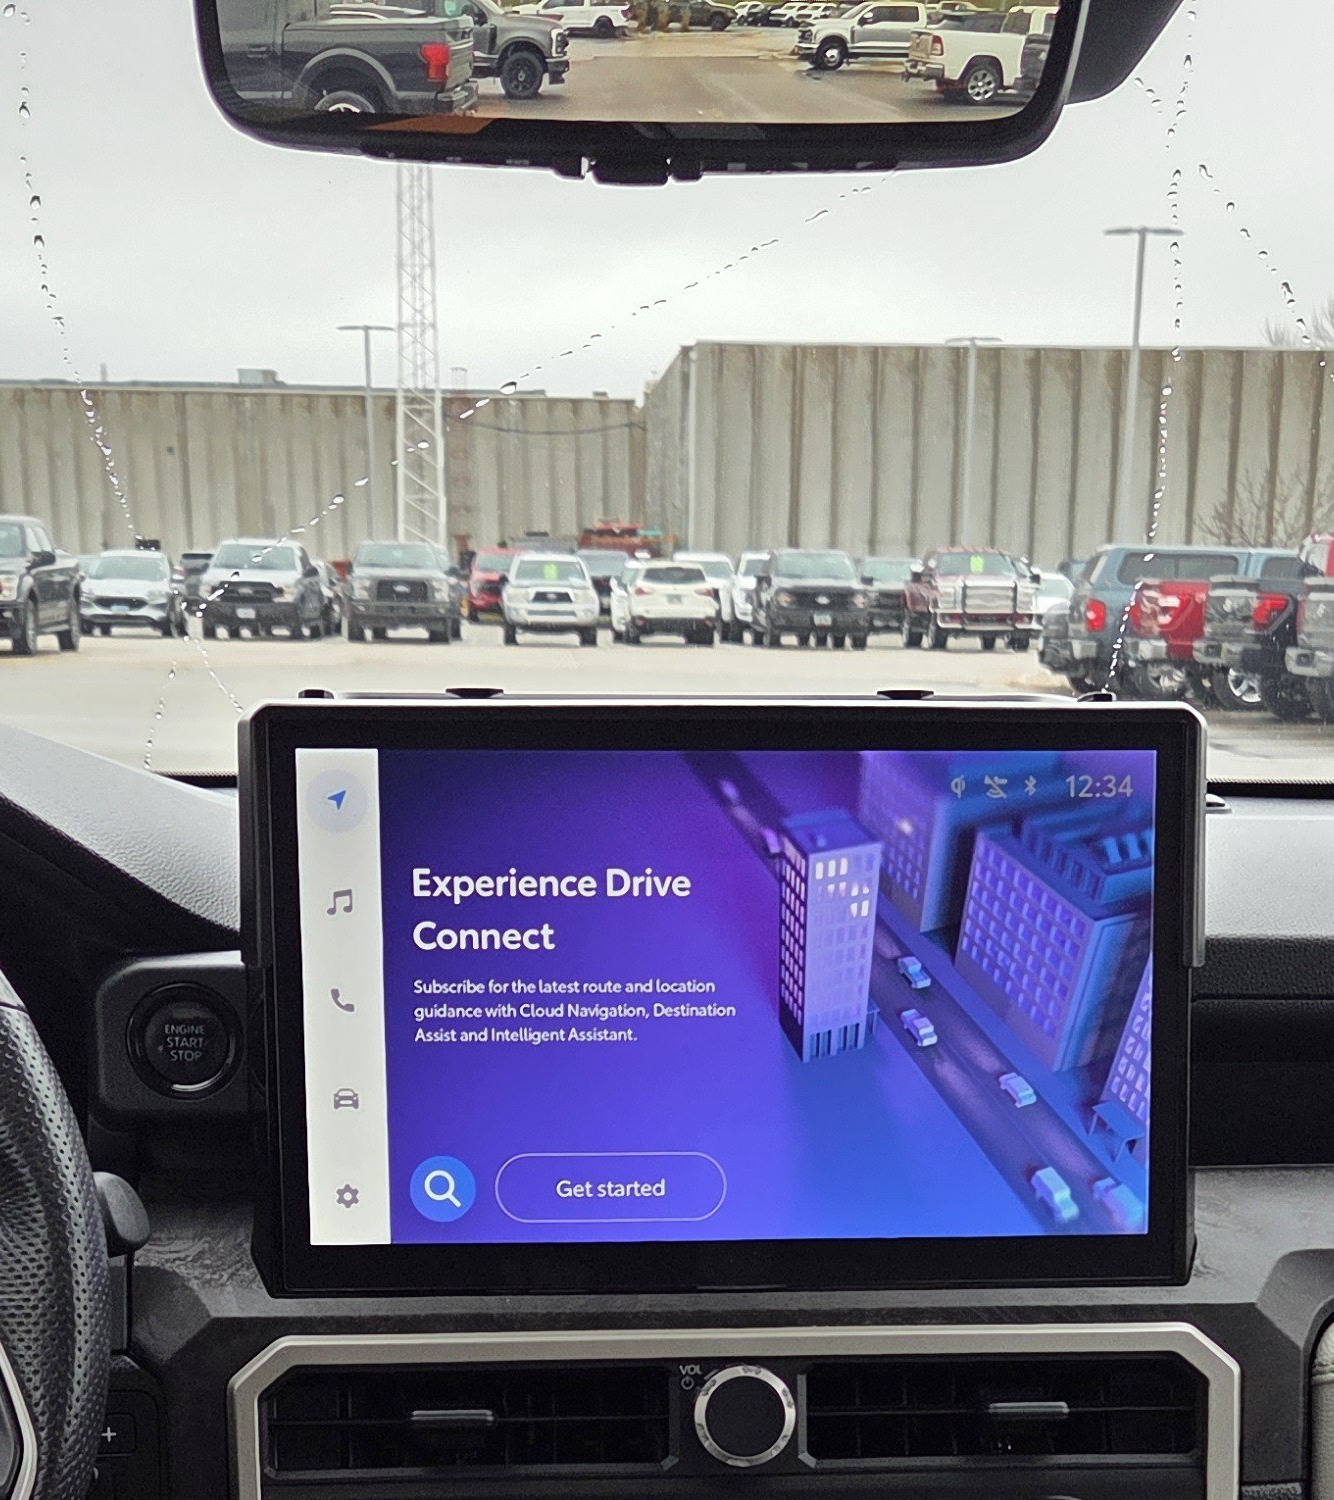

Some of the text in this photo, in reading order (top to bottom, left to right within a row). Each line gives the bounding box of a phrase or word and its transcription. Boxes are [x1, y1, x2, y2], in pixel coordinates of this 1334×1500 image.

[1066, 776, 1134, 798] 12:34
[412, 866, 692, 905] Experience Drive
[412, 922, 556, 951] Connect
[413, 979, 716, 995] Subscribe for the latest route and location
[414, 1003, 736, 1021] guidance with Cloud Navigation, Destination
[164, 1024, 205, 1035] ENGINE
[414, 1027, 638, 1046] Assist and Intelligent Assistant.
[166, 1037, 204, 1048] START
[170, 1050, 202, 1062] STOP
[556, 1179, 666, 1199] Get started
[679, 1364, 702, 1375] VOL
